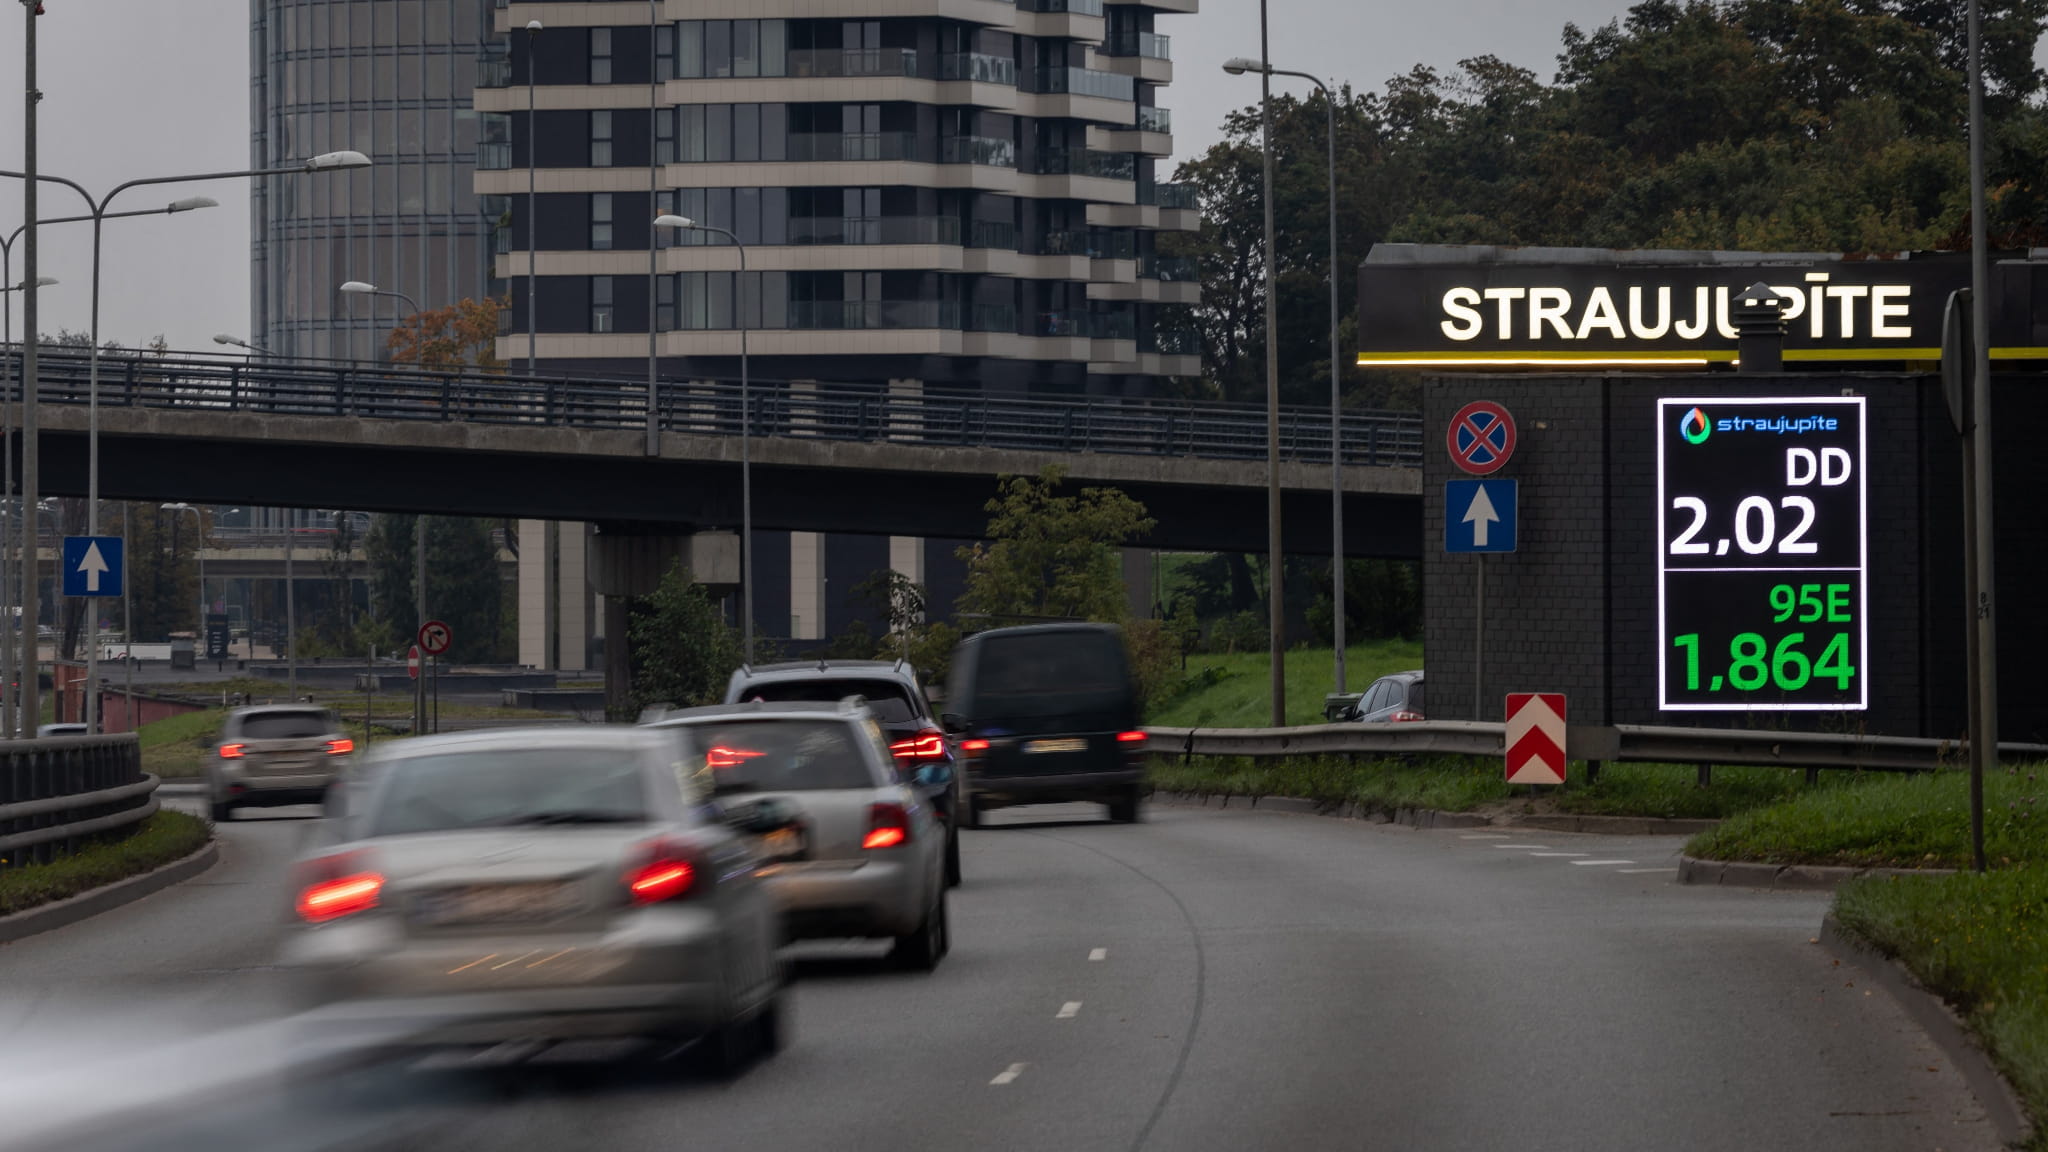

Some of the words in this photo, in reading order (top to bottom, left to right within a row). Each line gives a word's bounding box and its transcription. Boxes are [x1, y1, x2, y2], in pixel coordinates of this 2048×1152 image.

[1716, 415, 1838, 435] straujupīte
[1786, 448, 1851, 486] DD
[1670, 496, 1818, 555] 2,02
[1769, 584, 1852, 623] 95E
[1674, 632, 1855, 691] 1,864
